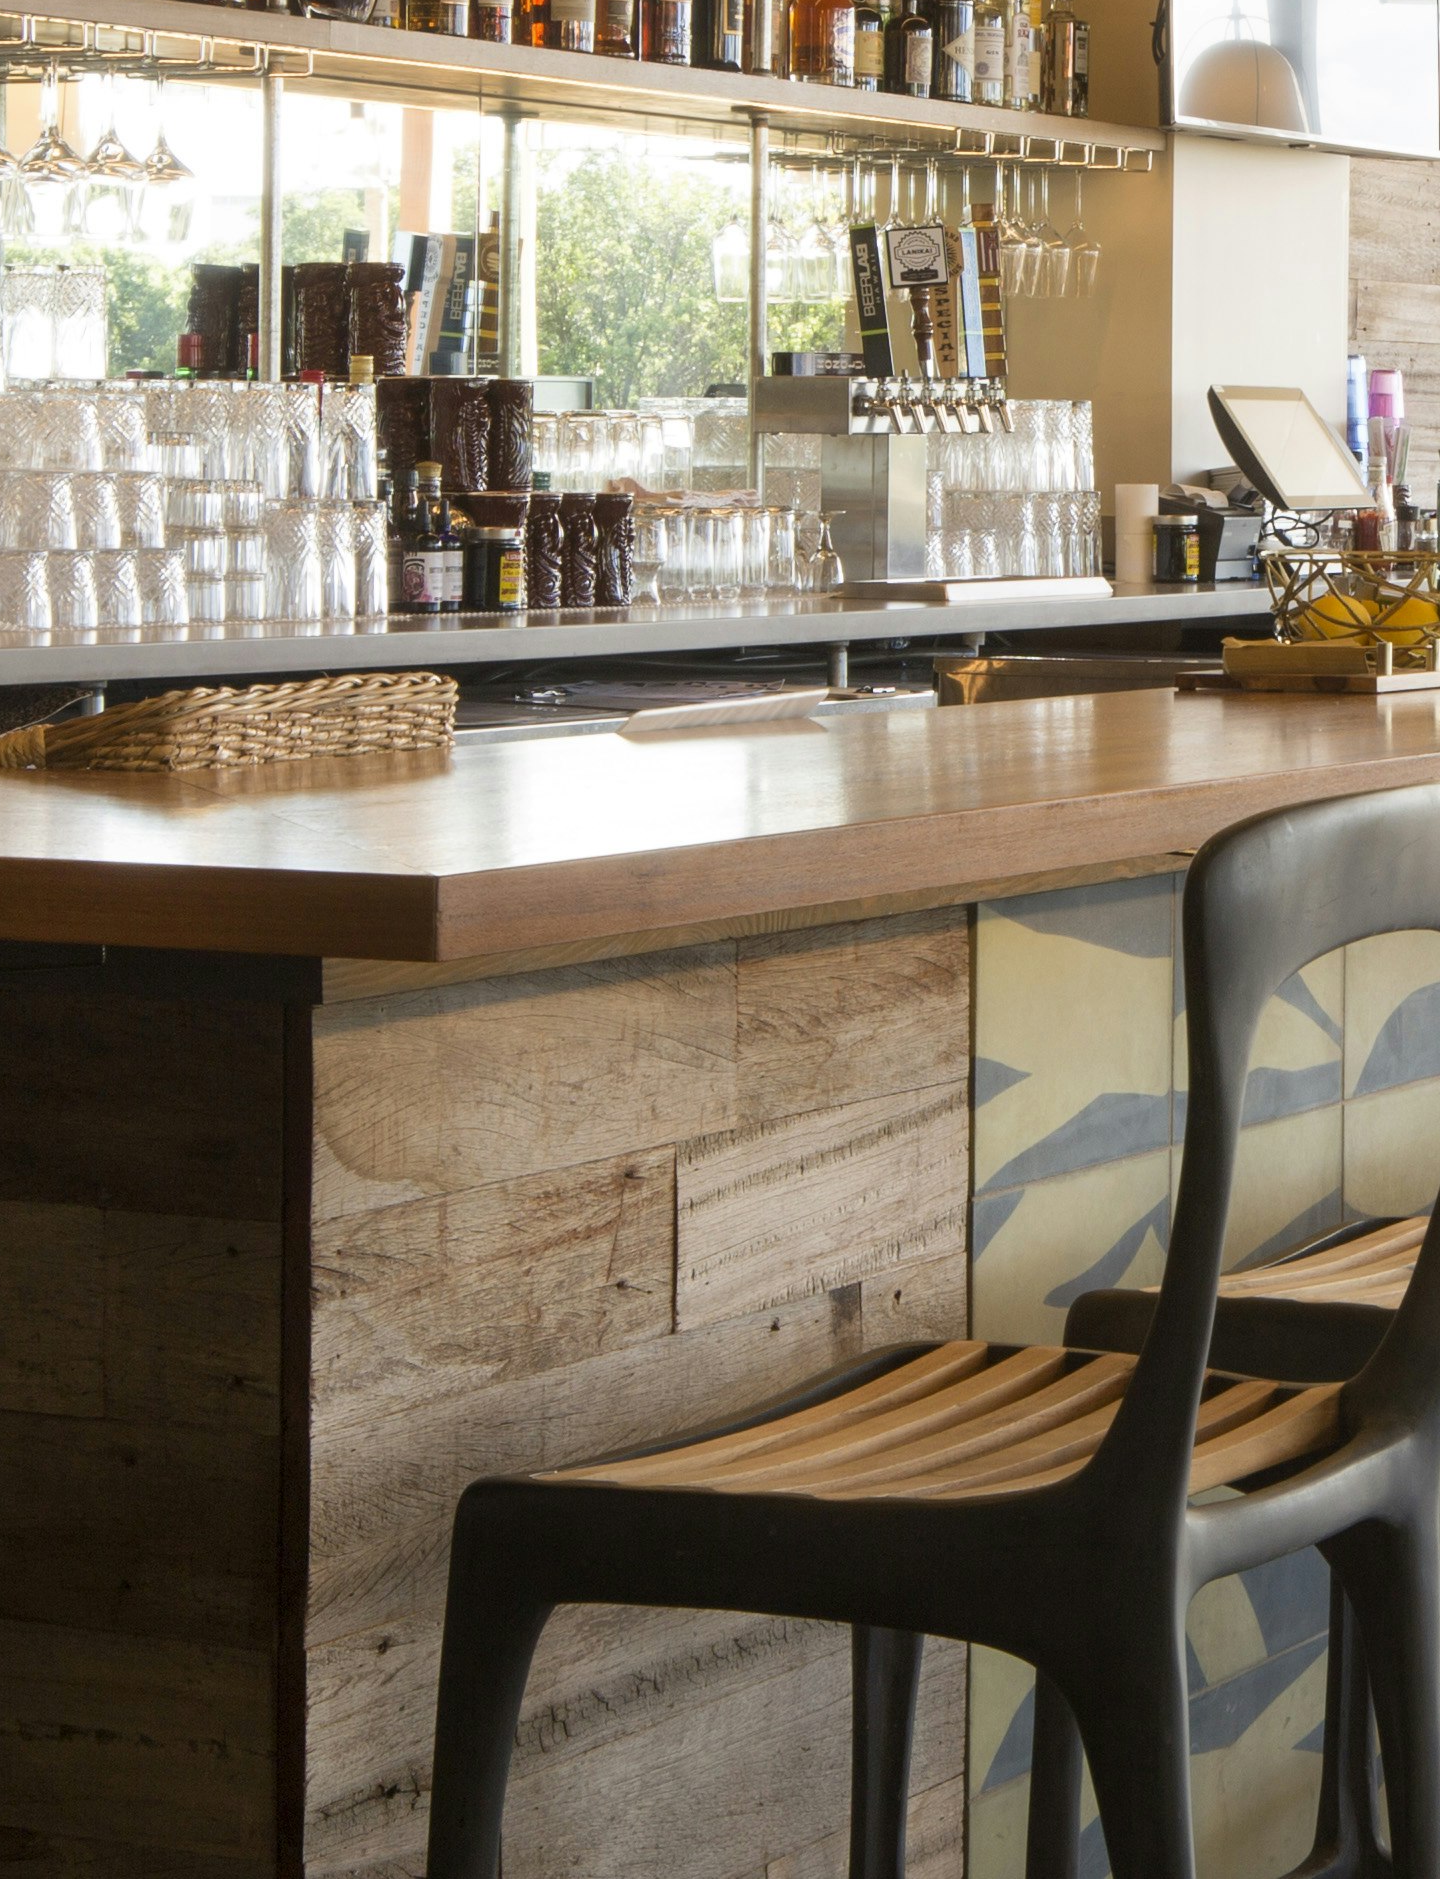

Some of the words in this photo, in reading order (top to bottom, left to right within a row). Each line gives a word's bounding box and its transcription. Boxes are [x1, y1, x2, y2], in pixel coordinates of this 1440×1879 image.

[901, 248, 933, 256] LANIKAI
[855, 243, 876, 317] BEERLAB
[934, 287, 955, 362] SPECIAL
[817, 360, 866, 370] HONOLU
